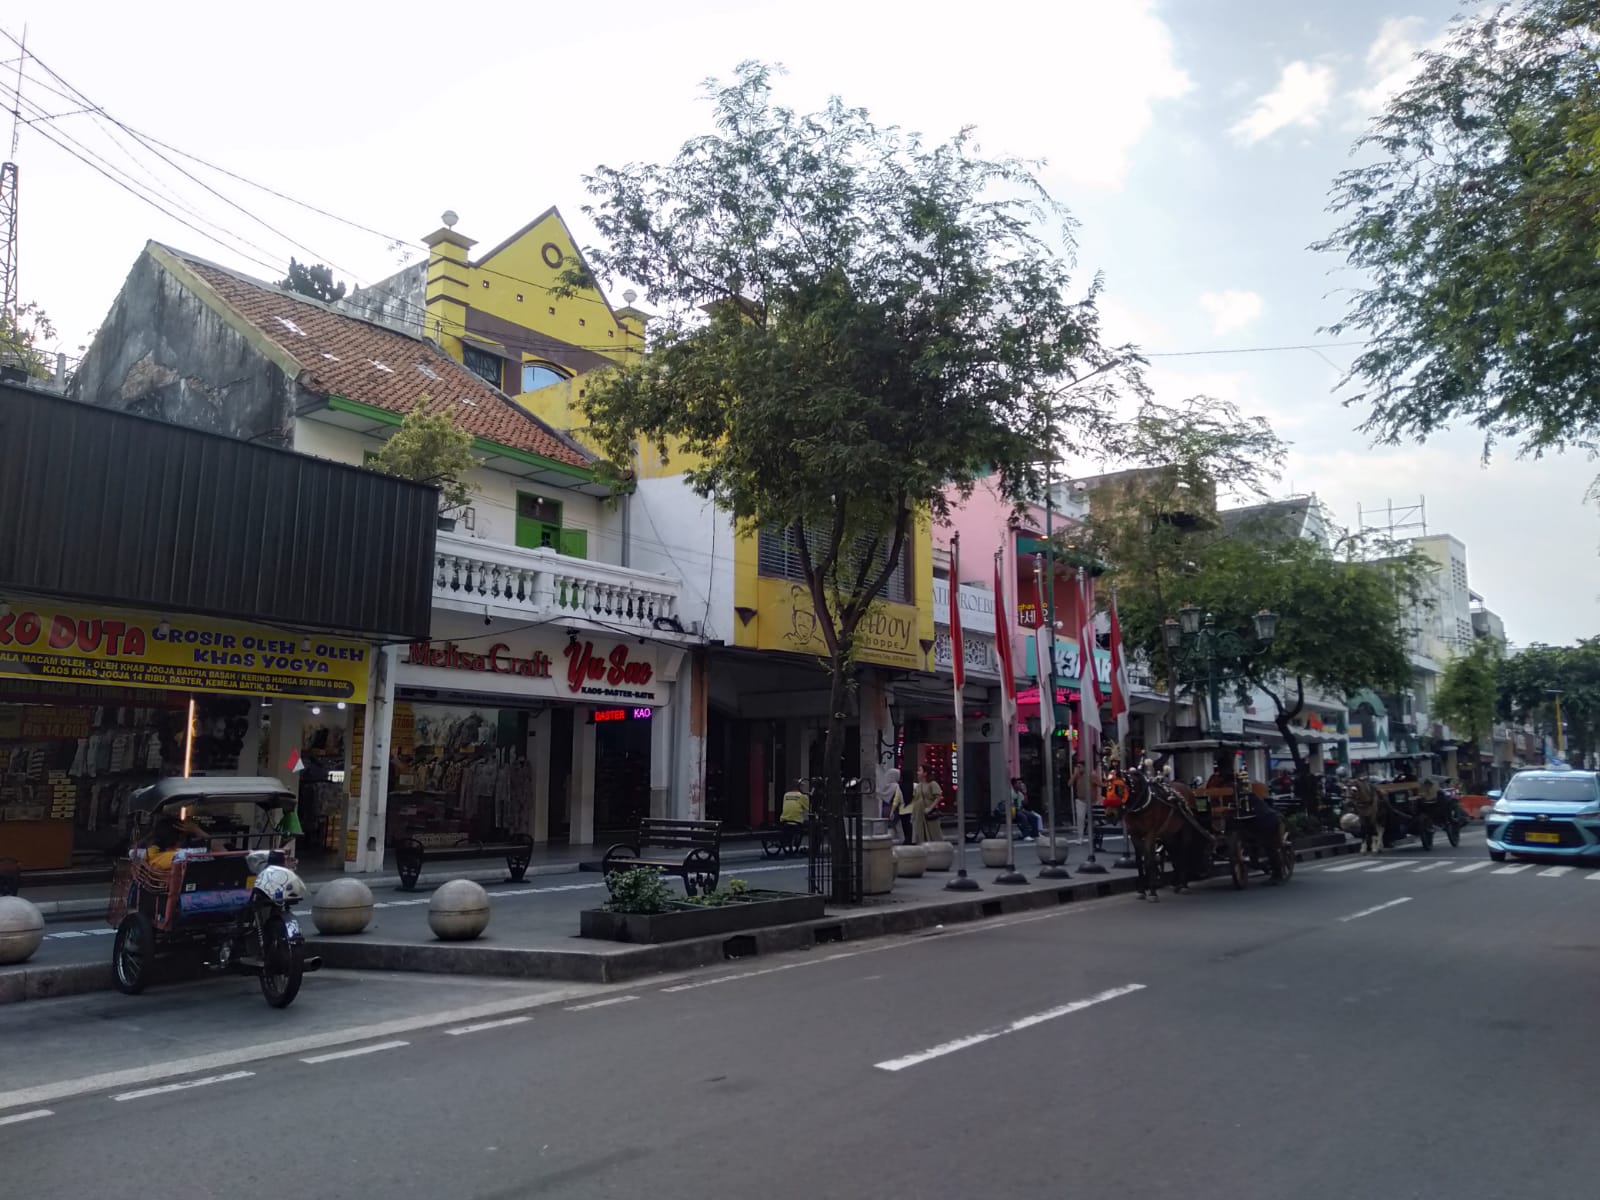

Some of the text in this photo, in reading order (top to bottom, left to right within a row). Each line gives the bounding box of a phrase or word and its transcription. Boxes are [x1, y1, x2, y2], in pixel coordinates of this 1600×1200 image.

[48, 614, 146, 656] DUTA
[151, 627, 236, 649] GROSIR
[242, 635, 296, 654] OLEH
[315, 643, 365, 661] OLEH
[22, 654, 57, 665] MACAM
[60, 657, 86, 667] OLEH
[93, 661, 118, 670] OLEH
[120, 663, 145, 672] KHAS
[146, 665, 175, 675] JOGJA
[176, 668, 207, 677] BAKPIA
[208, 671, 235, 680] BASAH
[271, 676, 297, 685] HARGA
[193, 648, 329, 673] KHAS YOGYA
[408, 640, 552, 678] Melisa Craft
[563, 641, 606, 692] Yu
[43, 665, 69, 675] KAOS
[71, 669, 98, 678] KHAS
[99, 671, 130, 681] JOGJA
[131, 673, 143, 681] 14
[144, 673, 168, 684] RIBU,
[169, 676, 204, 687] DASTER,
[205, 679, 237, 688] KEMEJA
[595, 710, 625, 721] DASTER
